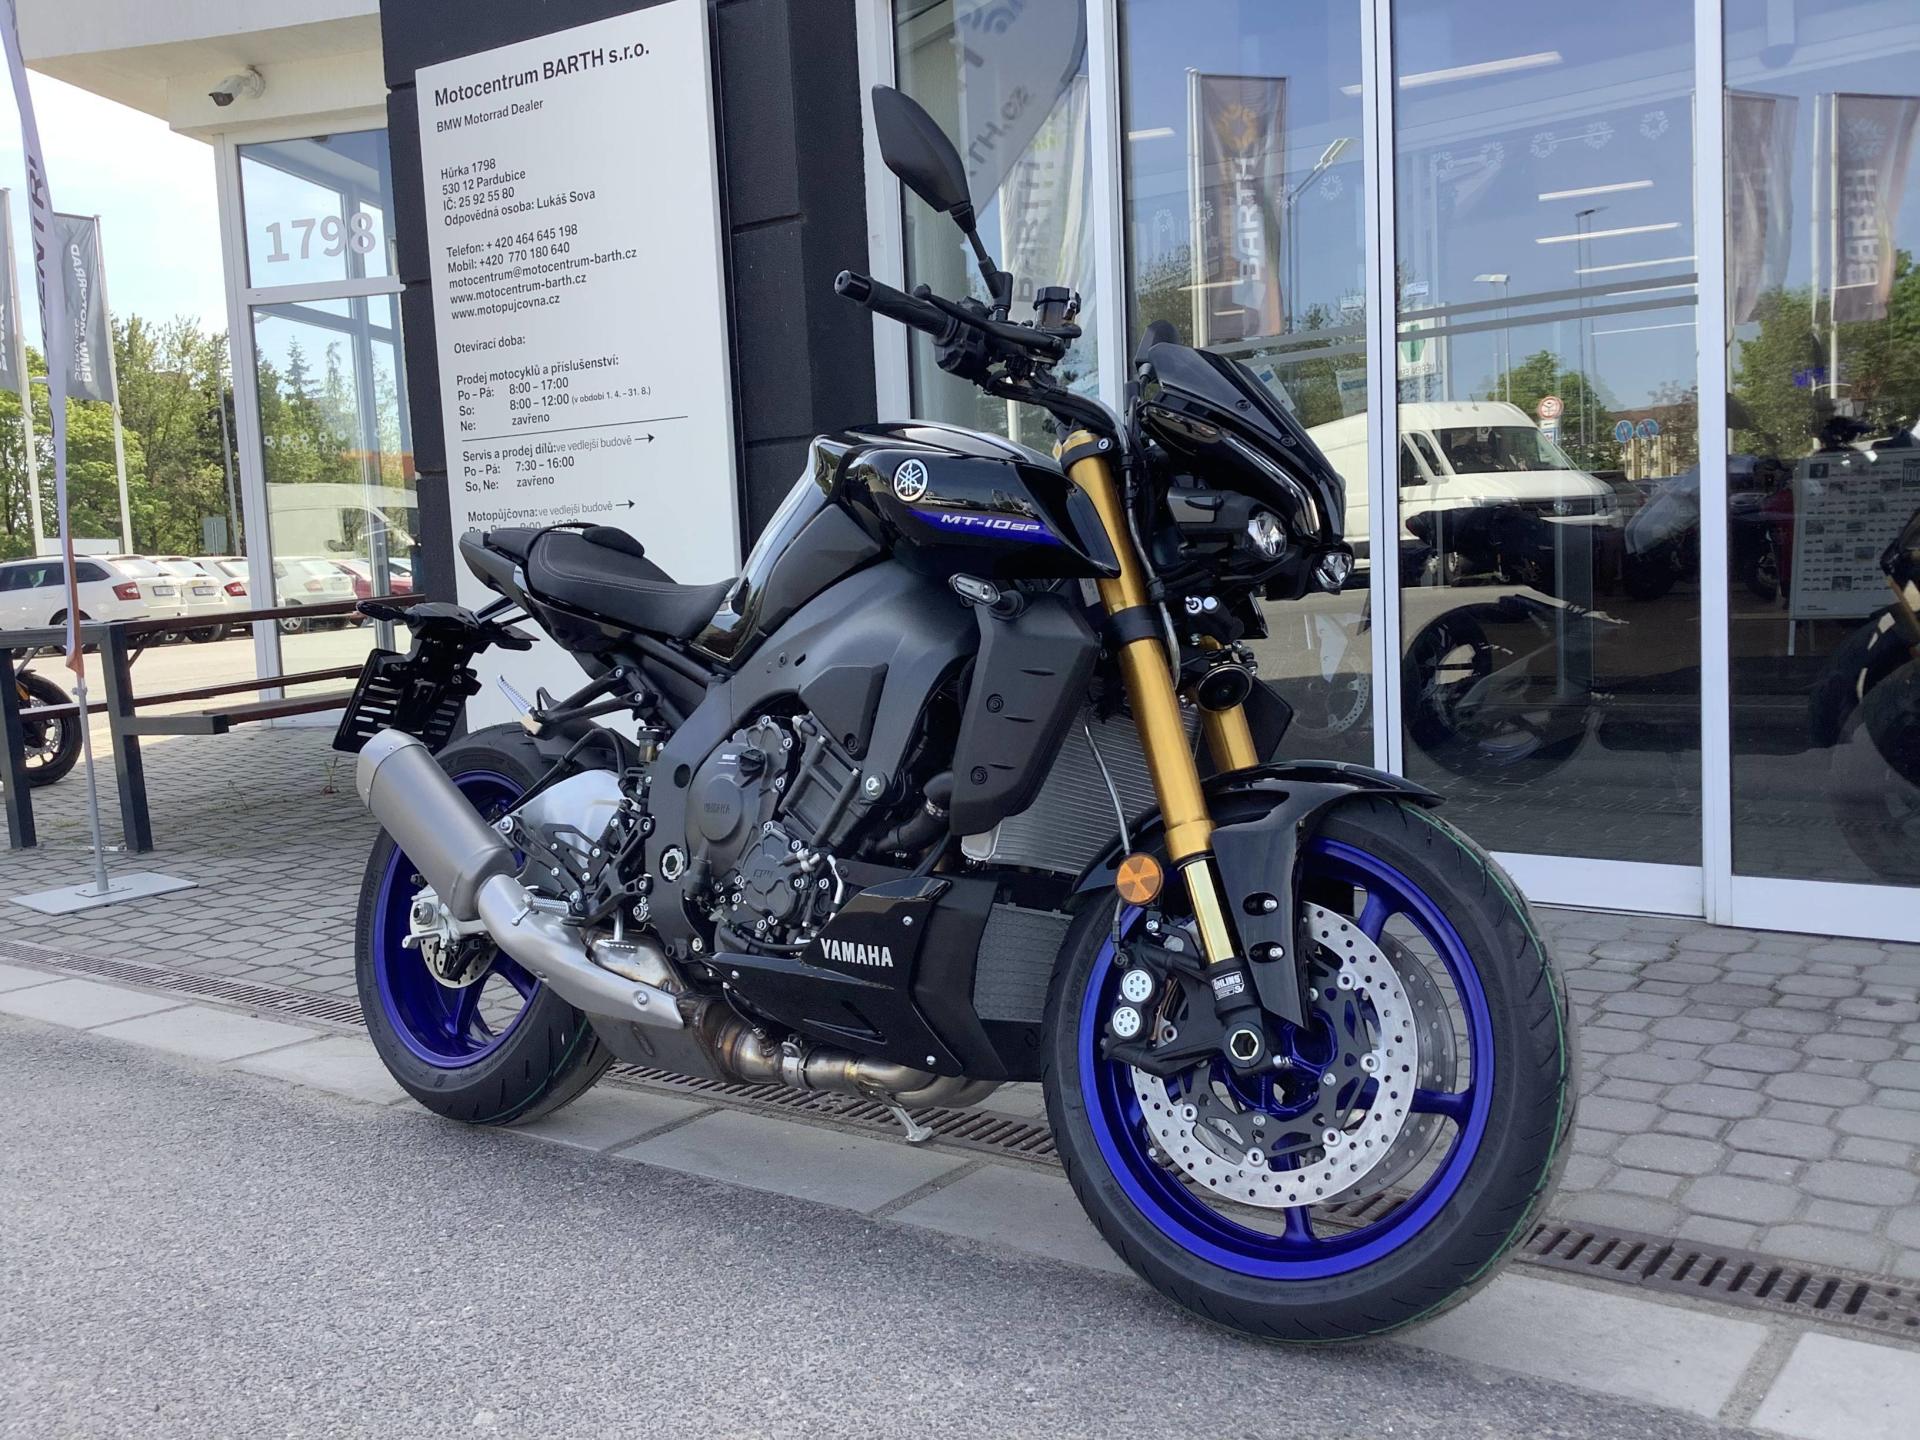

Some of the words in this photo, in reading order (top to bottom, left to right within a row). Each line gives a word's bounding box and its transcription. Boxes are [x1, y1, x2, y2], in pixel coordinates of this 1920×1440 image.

[434, 69, 539, 107] Motocentrum
[543, 48, 604, 80] BARTH
[608, 43, 650, 64] s.r.o.
[436, 116, 462, 133] BMW
[464, 105, 509, 126] Motorrad
[511, 99, 544, 115] Dealer
[471, 158, 496, 173] 1798
[442, 181, 461, 196] 530
[462, 178, 475, 191] 12
[476, 170, 526, 189] Pardubice
[444, 205, 499, 227] Odpovědná
[501, 200, 535, 216] osoba:
[536, 192, 568, 209] Lukáš
[569, 190, 596, 203] Sova
[458, 195, 471, 208] 25
[472, 192, 486, 205] 92
[487, 189, 500, 203] 55
[501, 186, 515, 200] 80
[266, 212, 376, 263] 1798
[446, 243, 485, 258] Telefon:
[494, 235, 514, 249] 420
[515, 232, 535, 245] 464
[536, 227, 556, 242] 645
[558, 223, 578, 237] 198
[447, 258, 478, 274] Mobil:
[508, 249, 528, 263] 770
[529, 245, 549, 259] 180
[550, 241, 570, 256] 640
[449, 249, 637, 289] motocentrum@motocentrum-barth.cz
[450, 274, 587, 304] www.motocentrum-barth.cz
[451, 295, 560, 320] www.motopujcovna.cz
[453, 337, 496, 354] Otevírací
[498, 335, 526, 348] doba:
[456, 371, 488, 386] Prodej
[489, 364, 541, 382] motocyklů
[542, 366, 549, 375] a
[457, 390, 471, 401] Po
[479, 386, 495, 399] Pá:
[509, 381, 531, 395] 8:00
[541, 376, 569, 391] 17:00
[459, 405, 475, 417] So:
[509, 397, 532, 411] 8:00
[541, 392, 570, 407] 12:00
[460, 420, 476, 432] Ne:
[511, 413, 550, 426] zavřeno
[462, 449, 493, 462] Servis
[494, 450, 500, 459] a
[502, 444, 533, 461] prodej
[599, 434, 633, 448] budově
[464, 466, 477, 477] Po
[485, 463, 501, 475] Pá:
[515, 459, 537, 472] 7:30
[546, 455, 575, 469] 16:00
[465, 481, 481, 493] So,
[482, 479, 499, 491] Ne:
[516, 475, 555, 488] zavřeno
[467, 508, 538, 523] Motopůjčovna:
[581, 500, 613, 514] budově
[820, 938, 894, 968] YAMAHA
